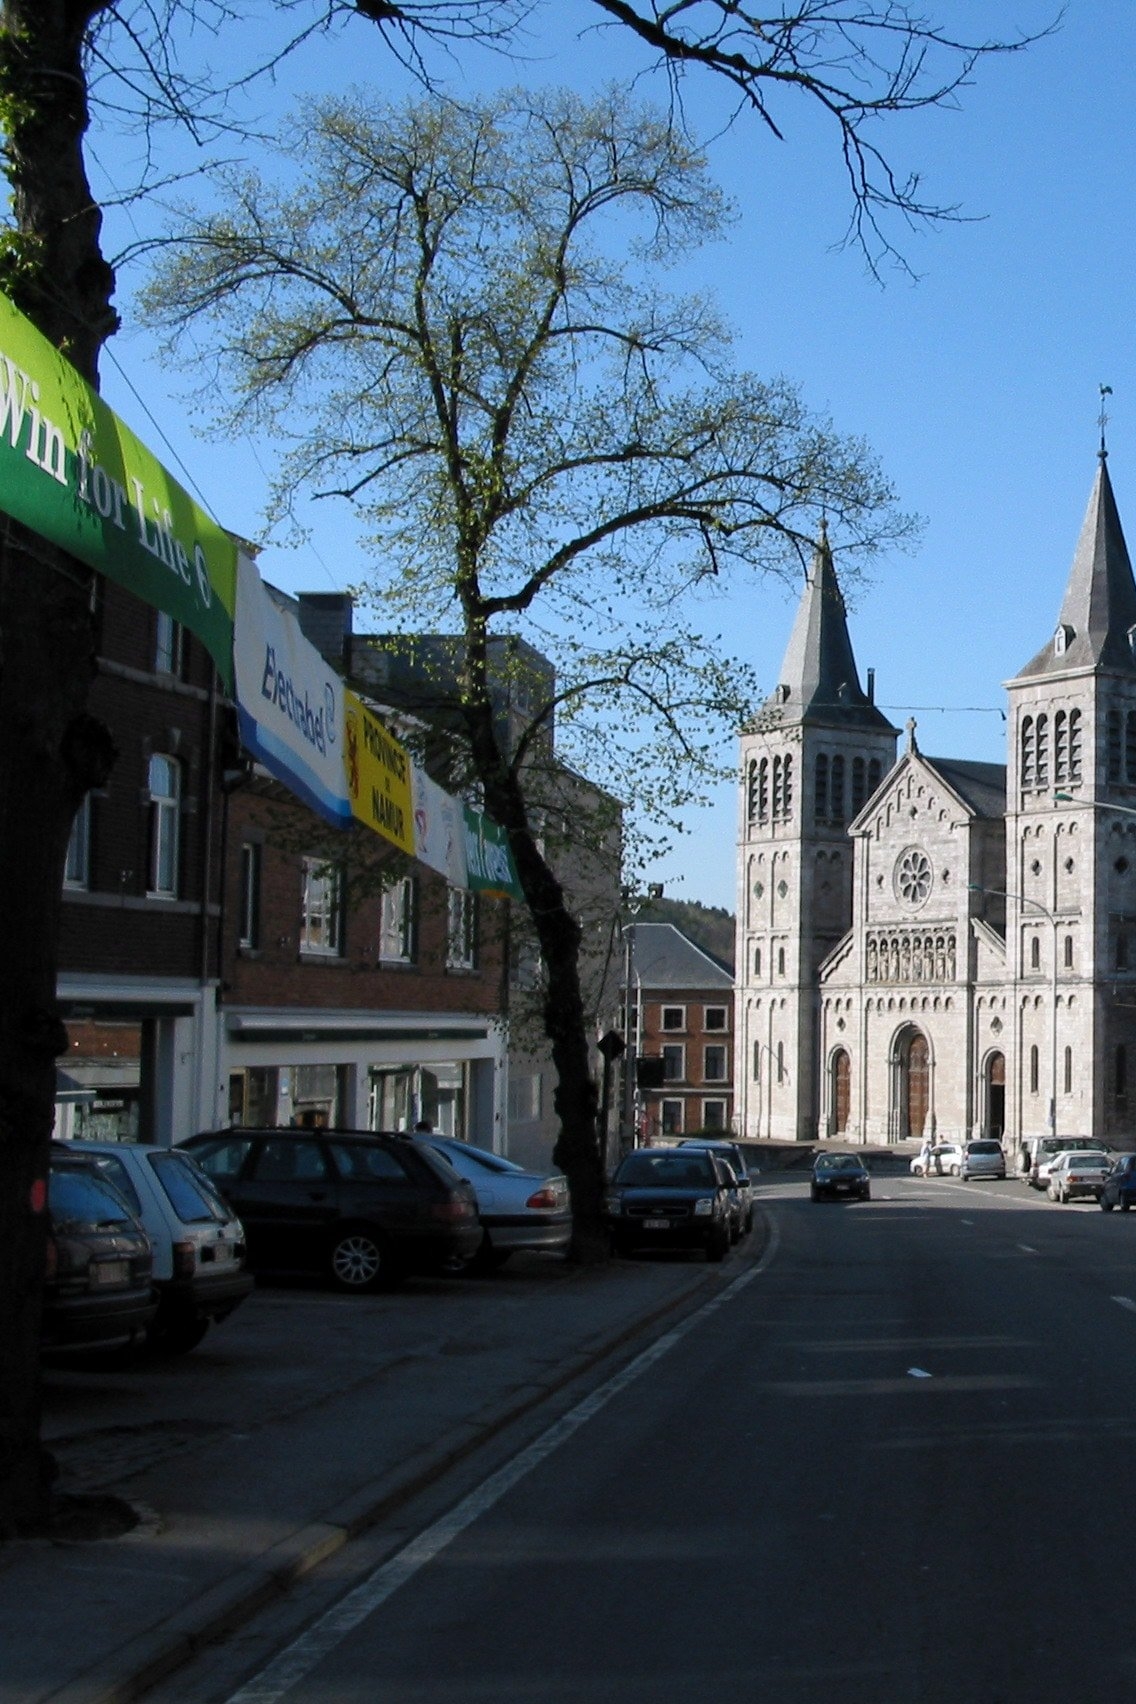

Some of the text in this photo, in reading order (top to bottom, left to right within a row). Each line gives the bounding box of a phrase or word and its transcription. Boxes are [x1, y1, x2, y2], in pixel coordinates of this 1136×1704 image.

[0, 355, 191, 587] Win for Life
